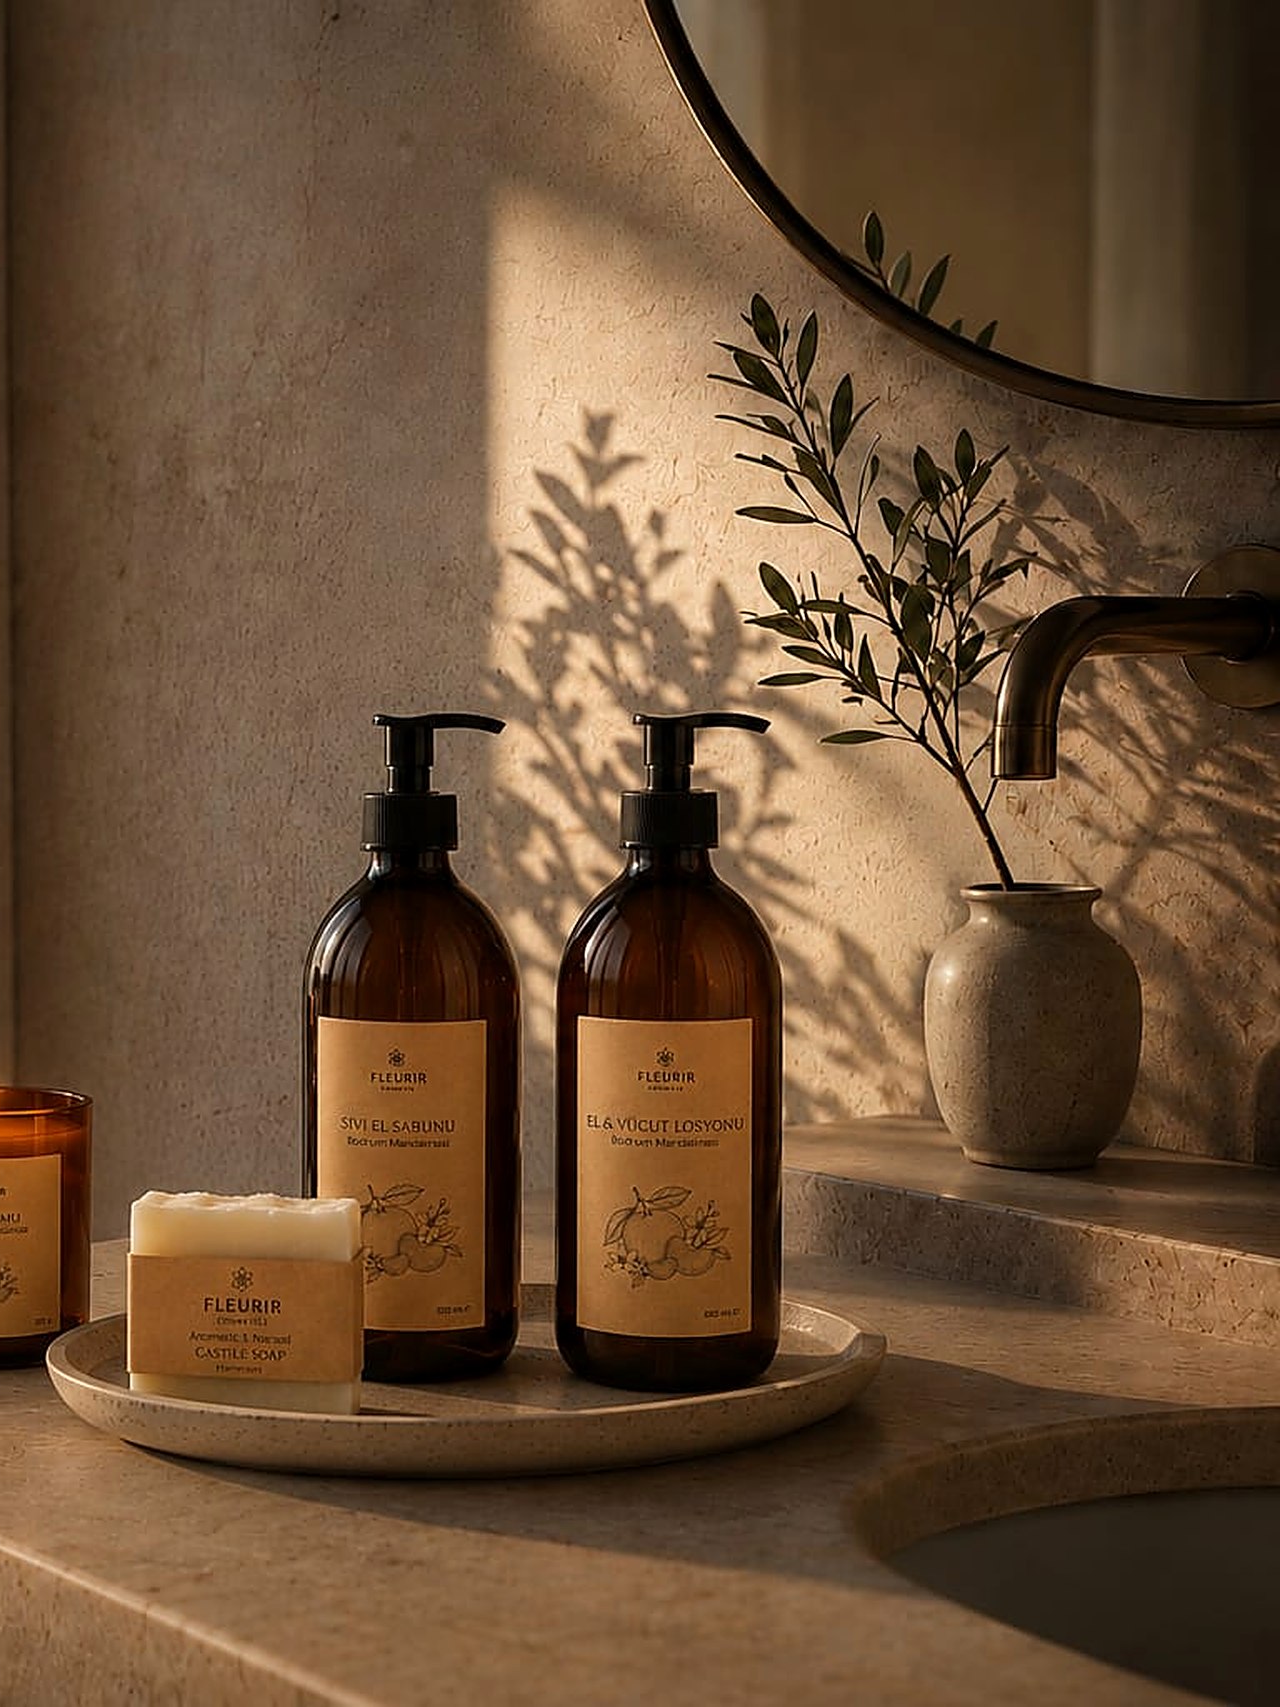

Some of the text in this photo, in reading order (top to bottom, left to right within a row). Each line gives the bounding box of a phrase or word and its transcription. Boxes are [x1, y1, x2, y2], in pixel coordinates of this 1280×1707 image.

[370, 1072, 427, 1084] FLEURIR
[637, 1071, 696, 1083] FLEURIR
[371, 1119, 389, 1133] EL
[392, 1119, 456, 1134] SABUNU
[587, 1114, 601, 1129] EL
[602, 1118, 613, 1130] &
[674, 1117, 744, 1133] LOSYONU
[204, 1297, 281, 1314] FLEURIR
[195, 1346, 287, 1361] CASTILE SOAP
